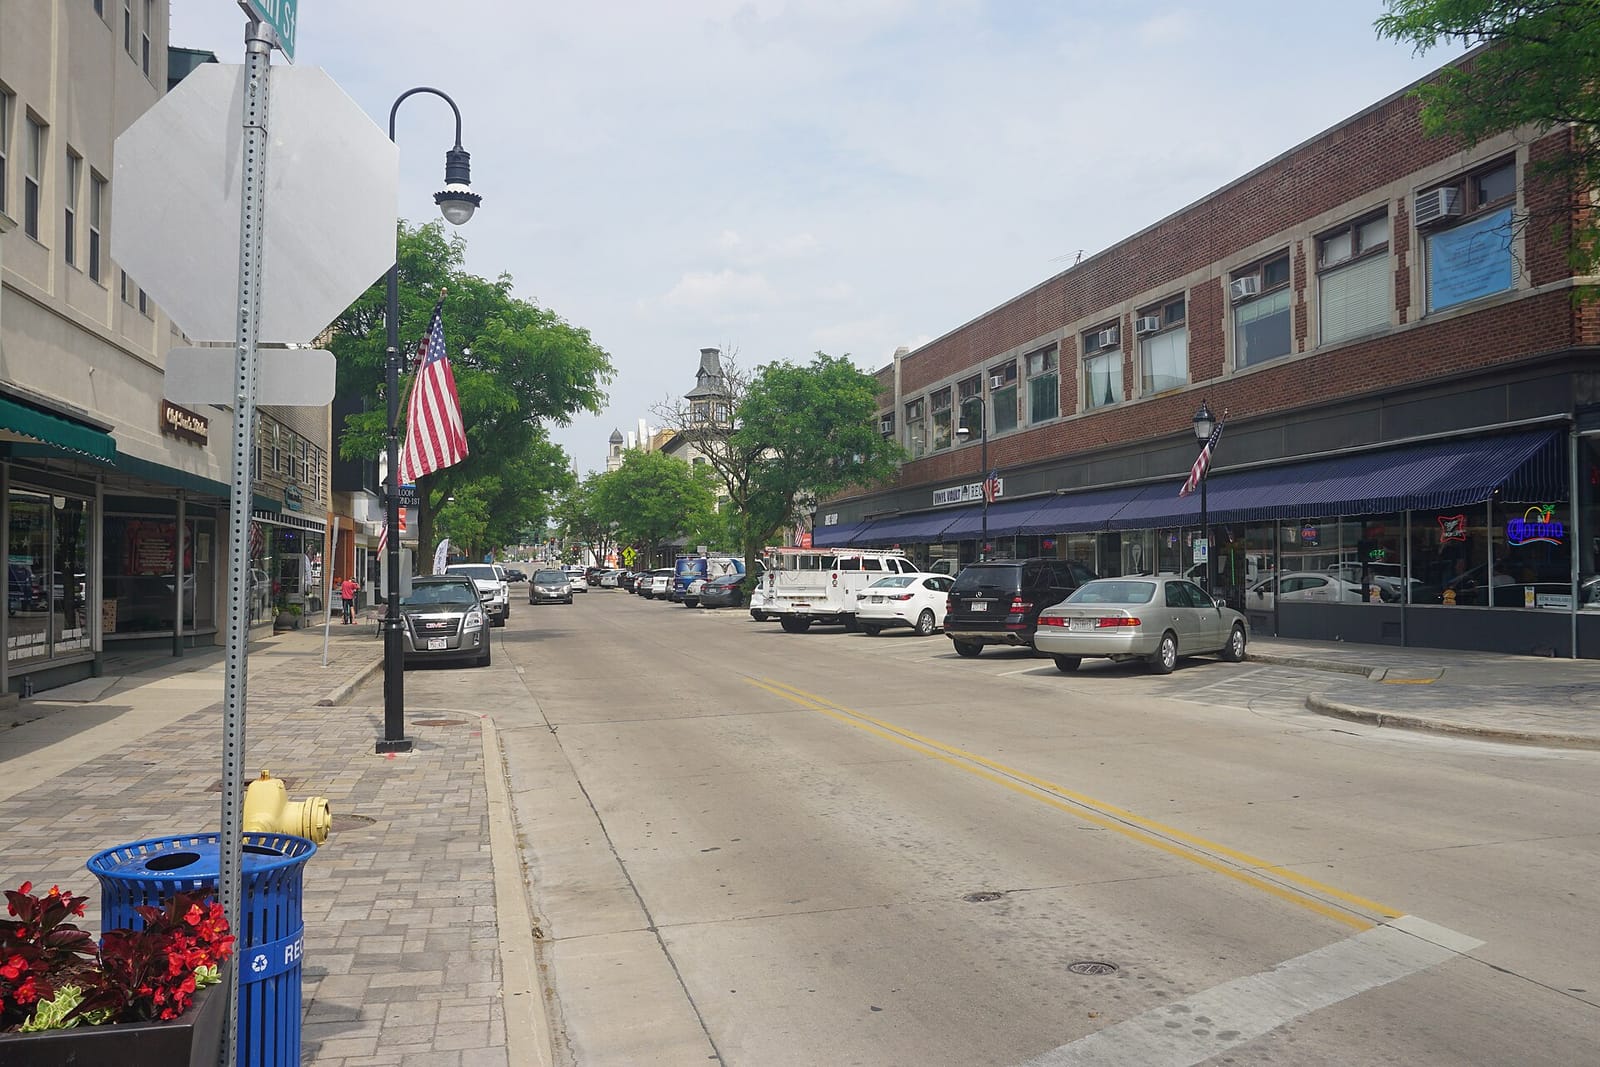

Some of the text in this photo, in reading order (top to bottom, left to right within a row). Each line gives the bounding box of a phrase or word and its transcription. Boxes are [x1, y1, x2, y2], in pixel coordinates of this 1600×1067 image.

[283, 2, 295, 48] St
[947, 488, 961, 502] VAULT
[1507, 517, 1564, 542] Corona
